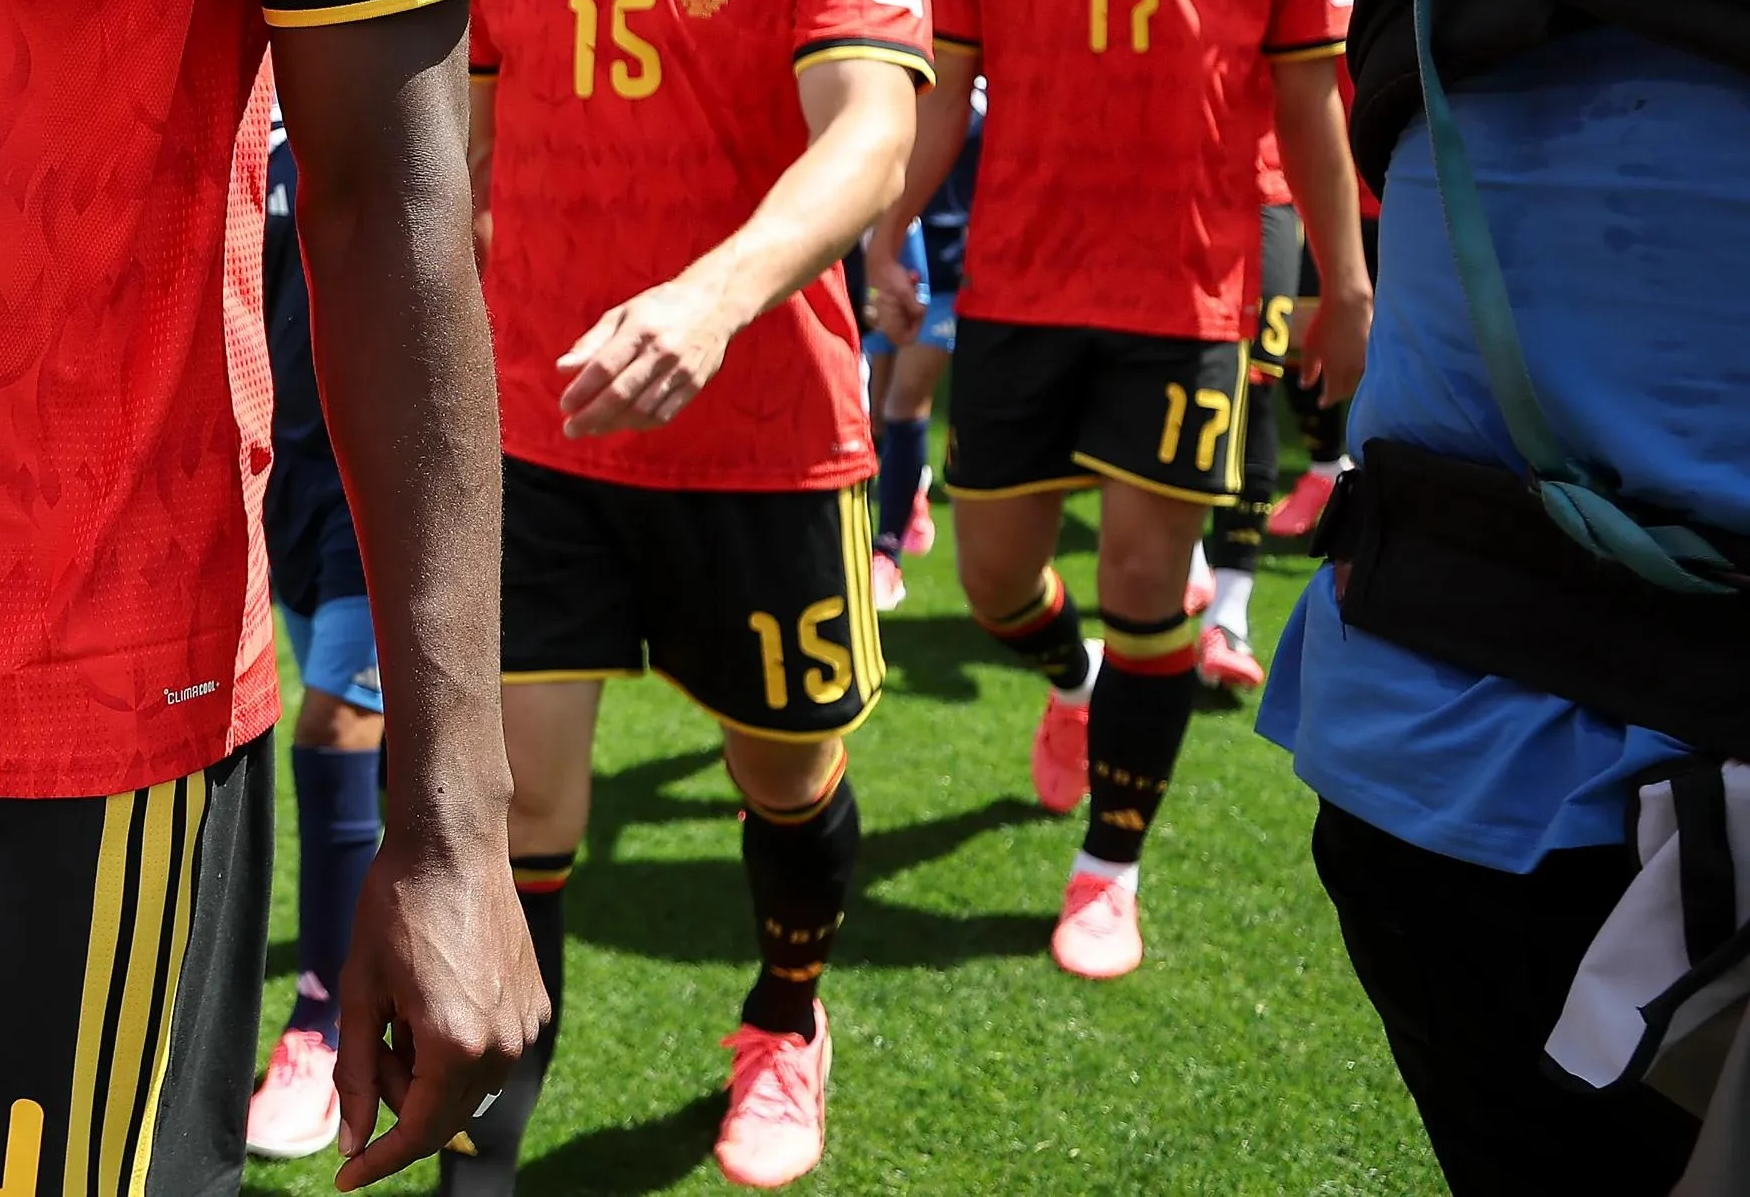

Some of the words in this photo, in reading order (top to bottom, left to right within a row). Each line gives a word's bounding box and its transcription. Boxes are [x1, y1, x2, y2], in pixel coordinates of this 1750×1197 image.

[1258, 295, 1294, 356] 5
[1157, 381, 1231, 472] 17
[749, 596, 853, 709] 15
